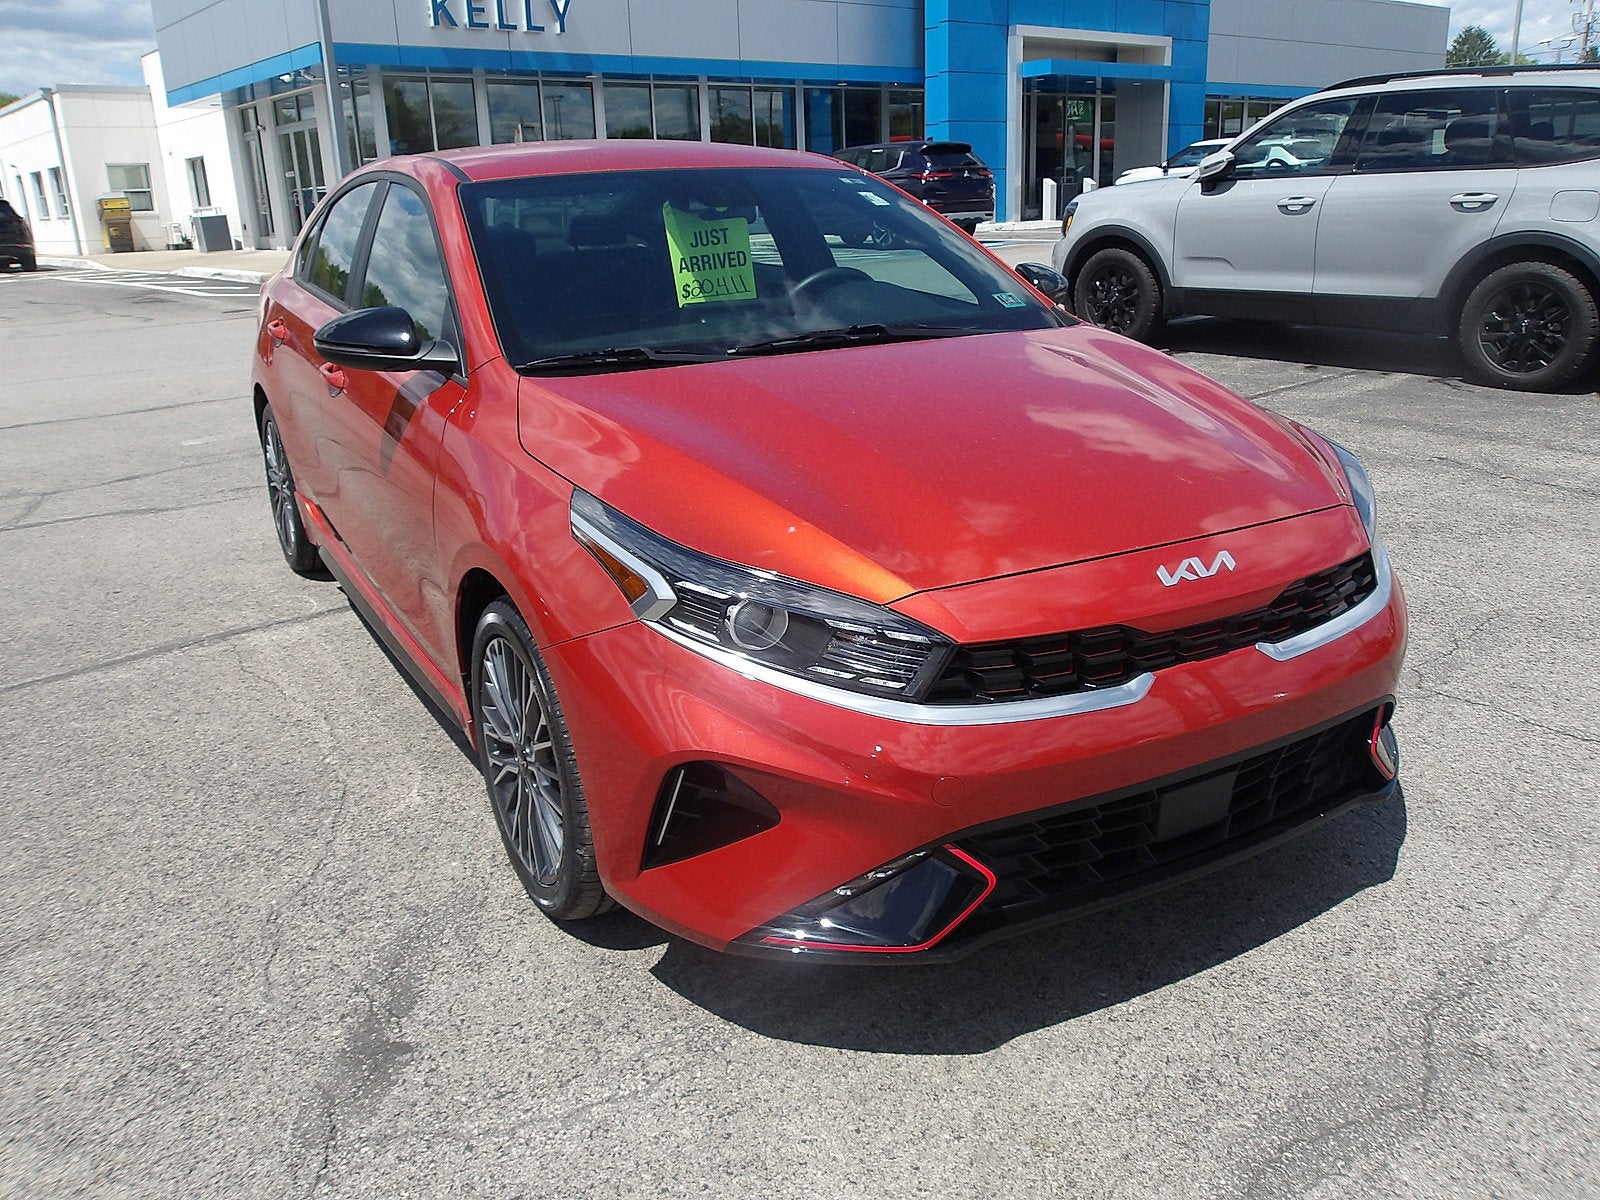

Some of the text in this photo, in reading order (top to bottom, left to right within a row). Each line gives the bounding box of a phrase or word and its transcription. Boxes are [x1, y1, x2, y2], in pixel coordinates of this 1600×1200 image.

[431, 0, 570, 33] KELLY
[690, 228, 729, 248] JUST
[679, 250, 747, 273] ARRIVED
[1156, 550, 1236, 587] KIA
